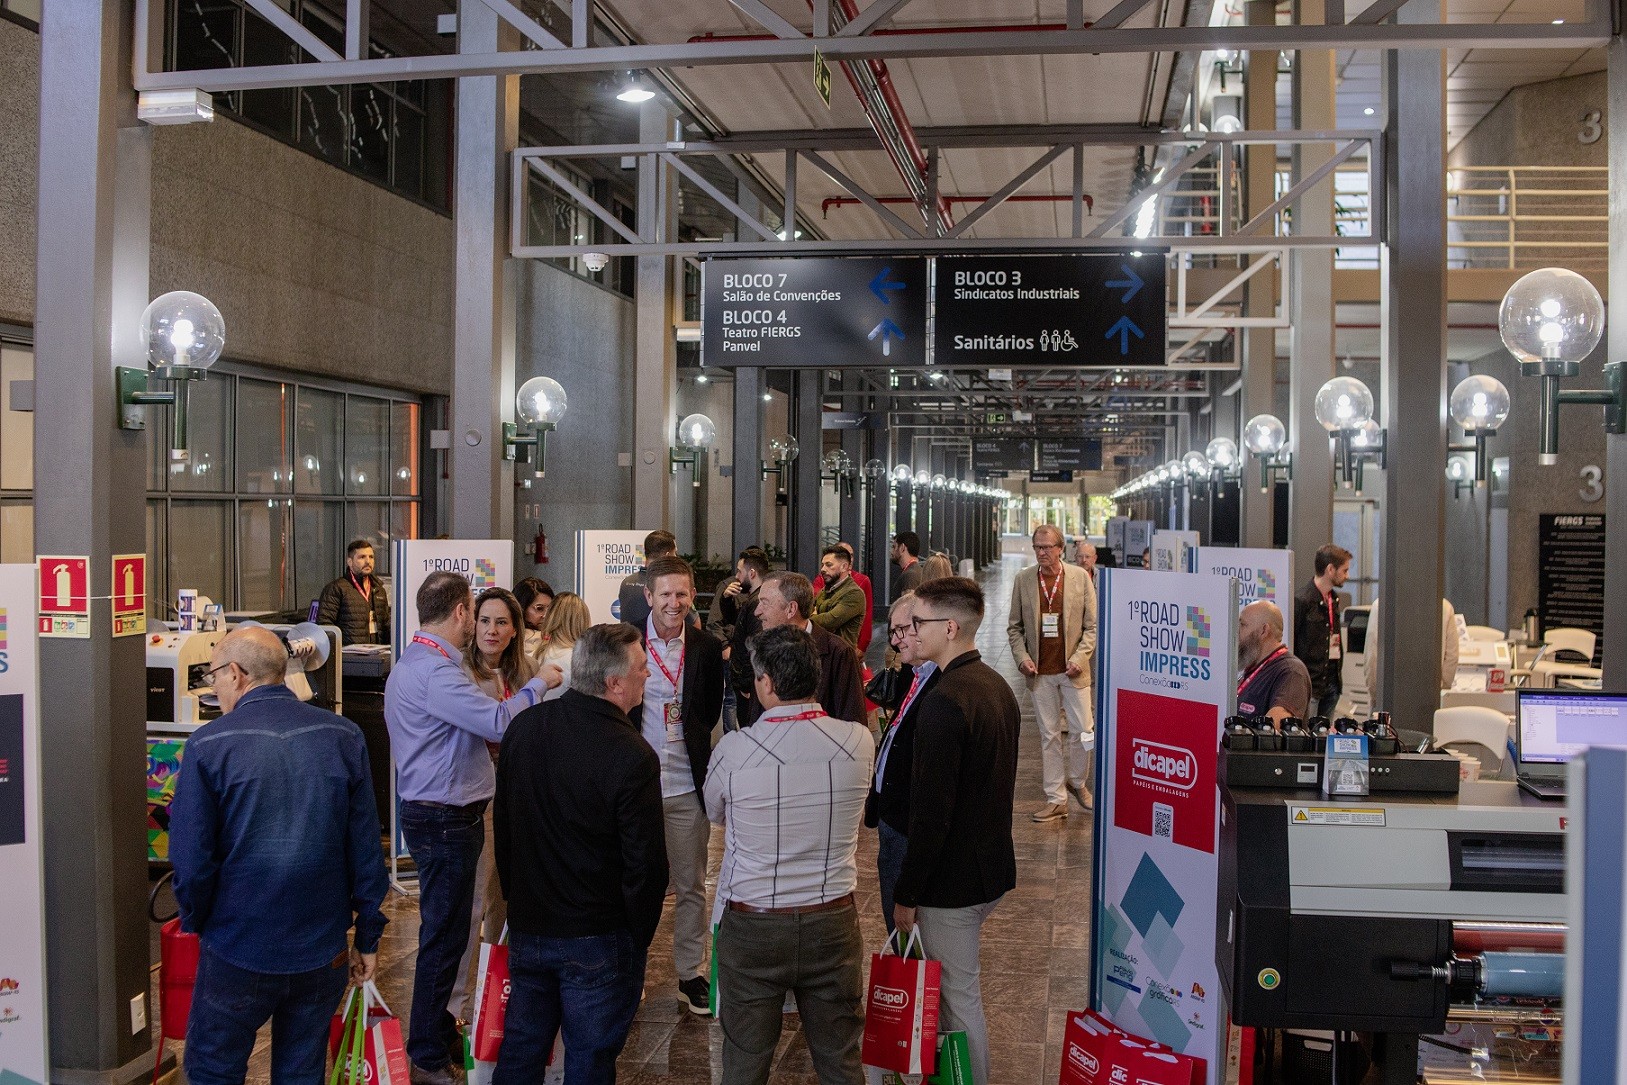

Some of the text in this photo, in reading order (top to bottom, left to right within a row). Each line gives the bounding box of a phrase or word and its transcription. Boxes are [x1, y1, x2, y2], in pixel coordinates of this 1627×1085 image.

[1578, 110, 1601, 144] 3
[723, 273, 787, 288] BLOCO 7
[955, 271, 1022, 286] BLOCO 3
[723, 290, 841, 303] Salão de Convenções
[954, 288, 1080, 300] Sindicatos Industriais
[723, 310, 787, 324] BLOCO 4
[723, 326, 801, 338] Teatro FIERGS
[723, 341, 761, 352] Panvel
[954, 334, 1035, 350] Sanitários
[1579, 464, 1603, 502] 3
[605, 543, 631, 553] ROAD
[434, 558, 470, 572] ROAD
[605, 554, 635, 565] SHOW
[1140, 600, 1180, 627] ROAD
[1140, 625, 1185, 653] SHOW
[1140, 650, 1211, 681] IMPRESS
[1133, 745, 1190, 779] dicapel
[873, 988, 904, 1004] dicapel
[1070, 1046, 1097, 1070] dicapel
